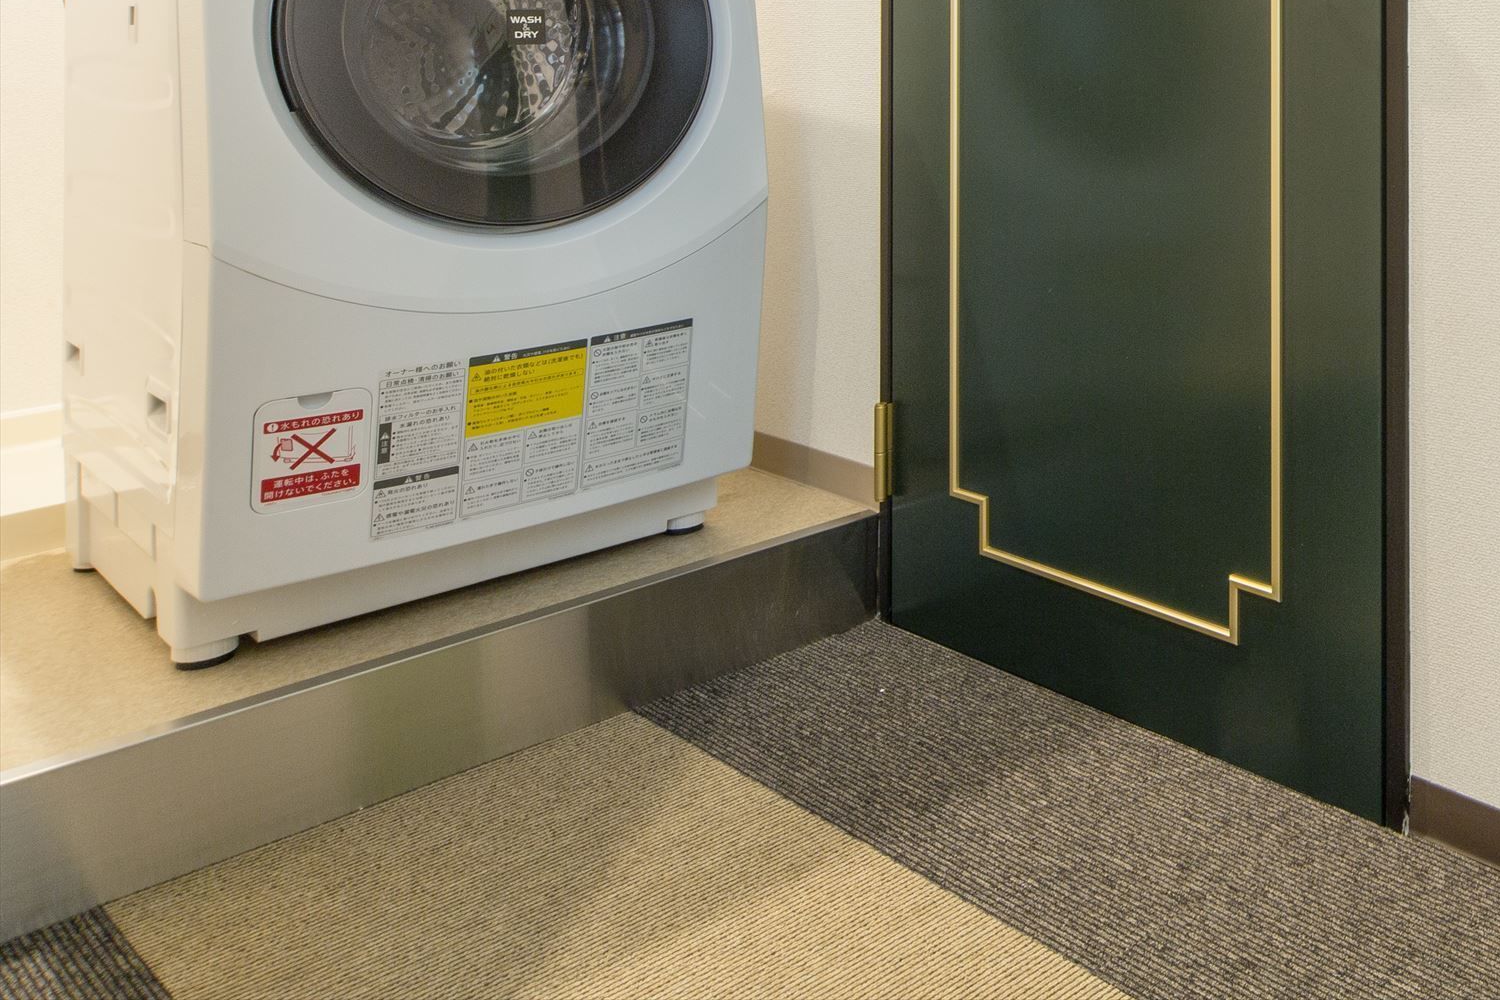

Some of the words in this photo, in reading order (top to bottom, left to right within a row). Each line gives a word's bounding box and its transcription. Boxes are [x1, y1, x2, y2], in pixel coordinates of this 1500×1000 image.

[510, 16, 542, 24] WASH
[522, 23, 530, 31] &
[514, 31, 539, 39] DRY
[386, 361, 461, 377] オーナー様へのお願い
[280, 411, 360, 430] 水もれの恐れあり
[273, 468, 350, 488] 運転中は、ふたを
[264, 478, 357, 500] 開けないでください。
